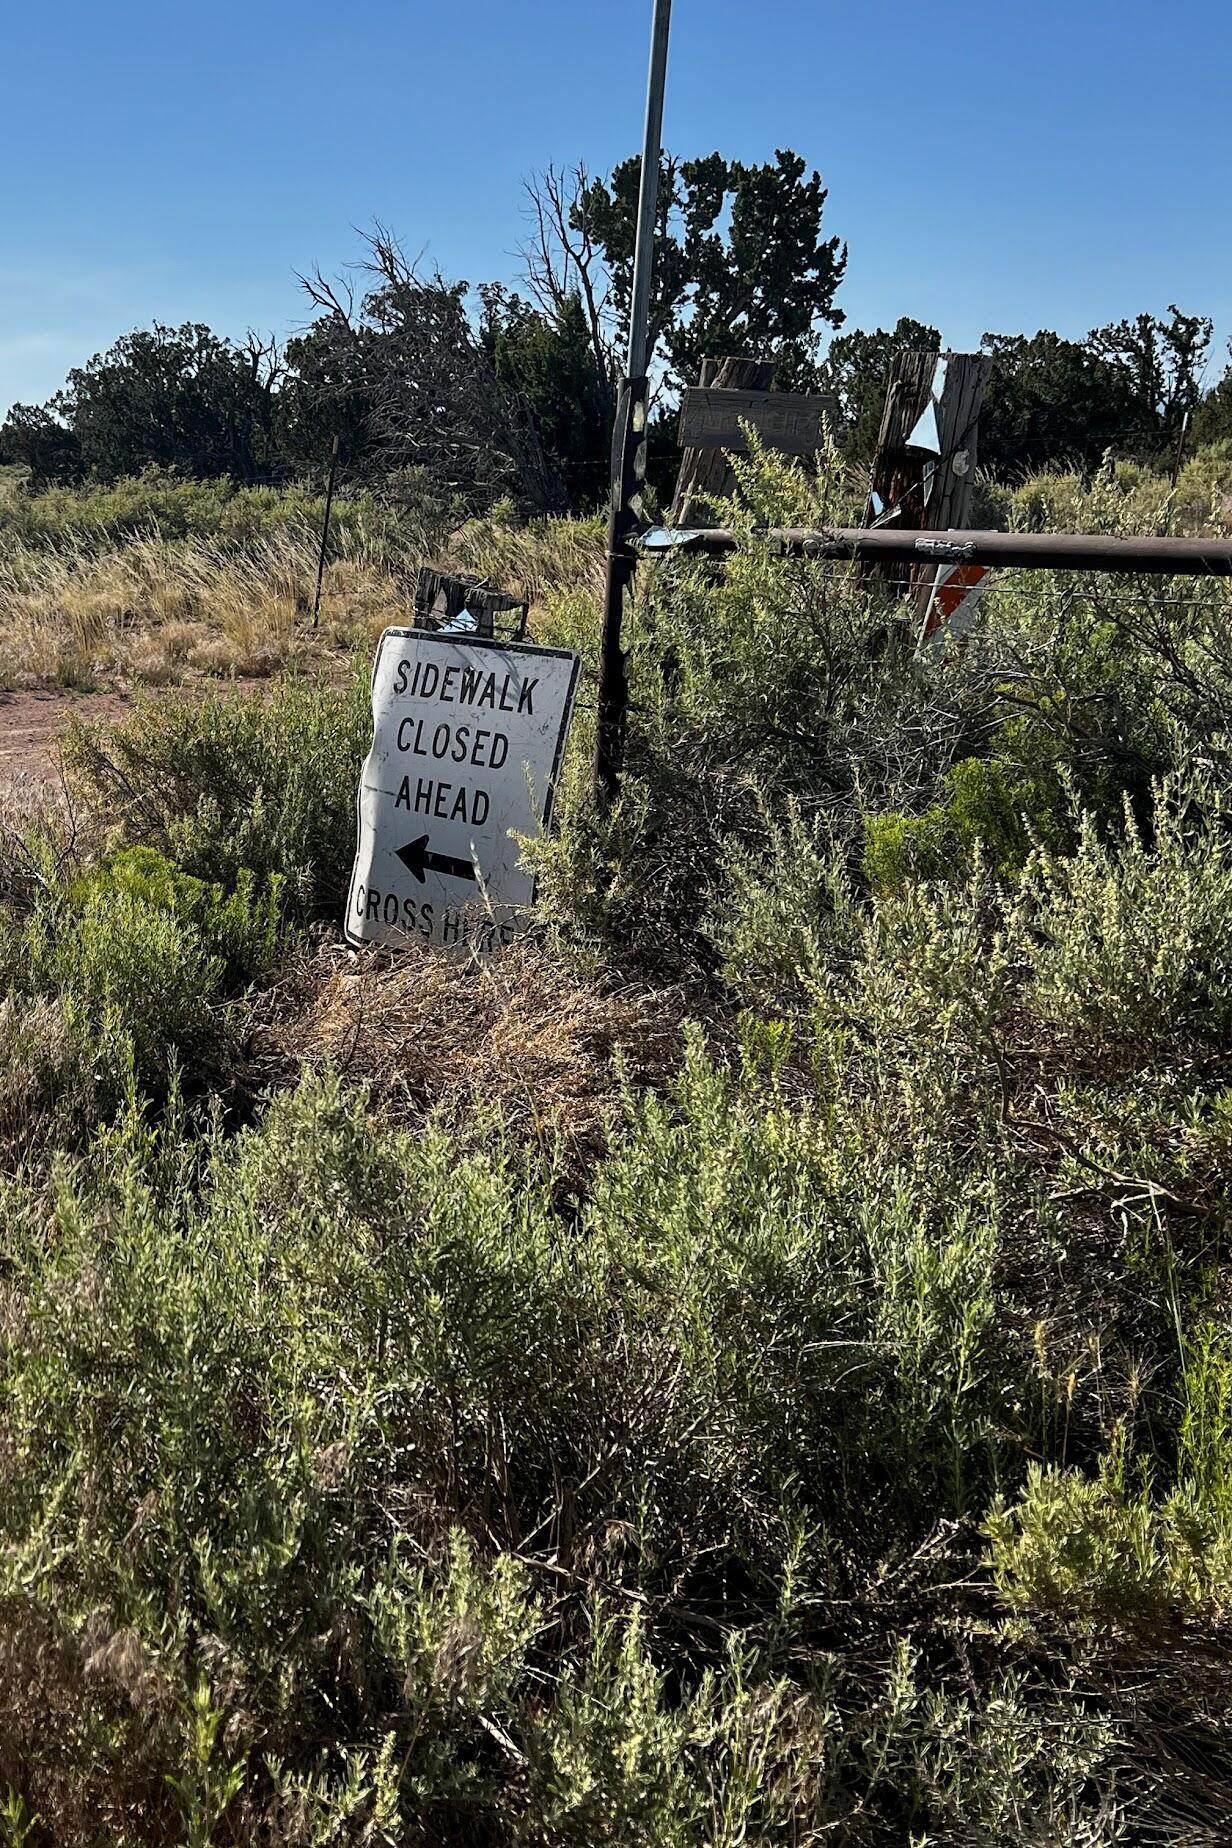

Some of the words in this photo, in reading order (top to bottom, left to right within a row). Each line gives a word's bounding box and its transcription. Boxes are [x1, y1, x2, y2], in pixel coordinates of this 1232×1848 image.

[393, 659, 540, 715] SIDEWALK
[397, 717, 509, 769] CLOSED
[394, 775, 490, 826] AHEAD
[356, 884, 434, 938] CROSS
